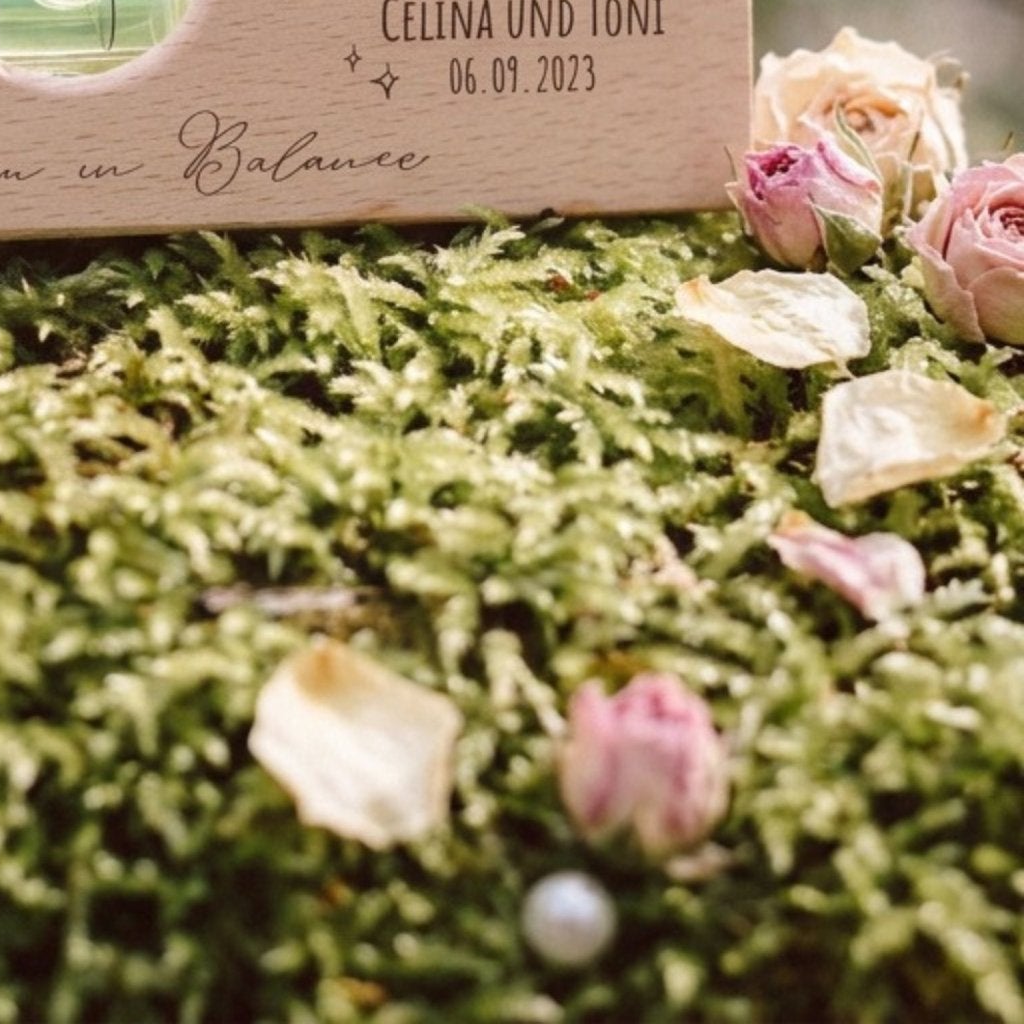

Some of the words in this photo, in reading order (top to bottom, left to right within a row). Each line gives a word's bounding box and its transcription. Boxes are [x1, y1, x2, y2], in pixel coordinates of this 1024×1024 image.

[449, 54, 596, 95] 06.09.2023
[78, 160, 144, 179] in
[178, 109, 431, 197] Balance
